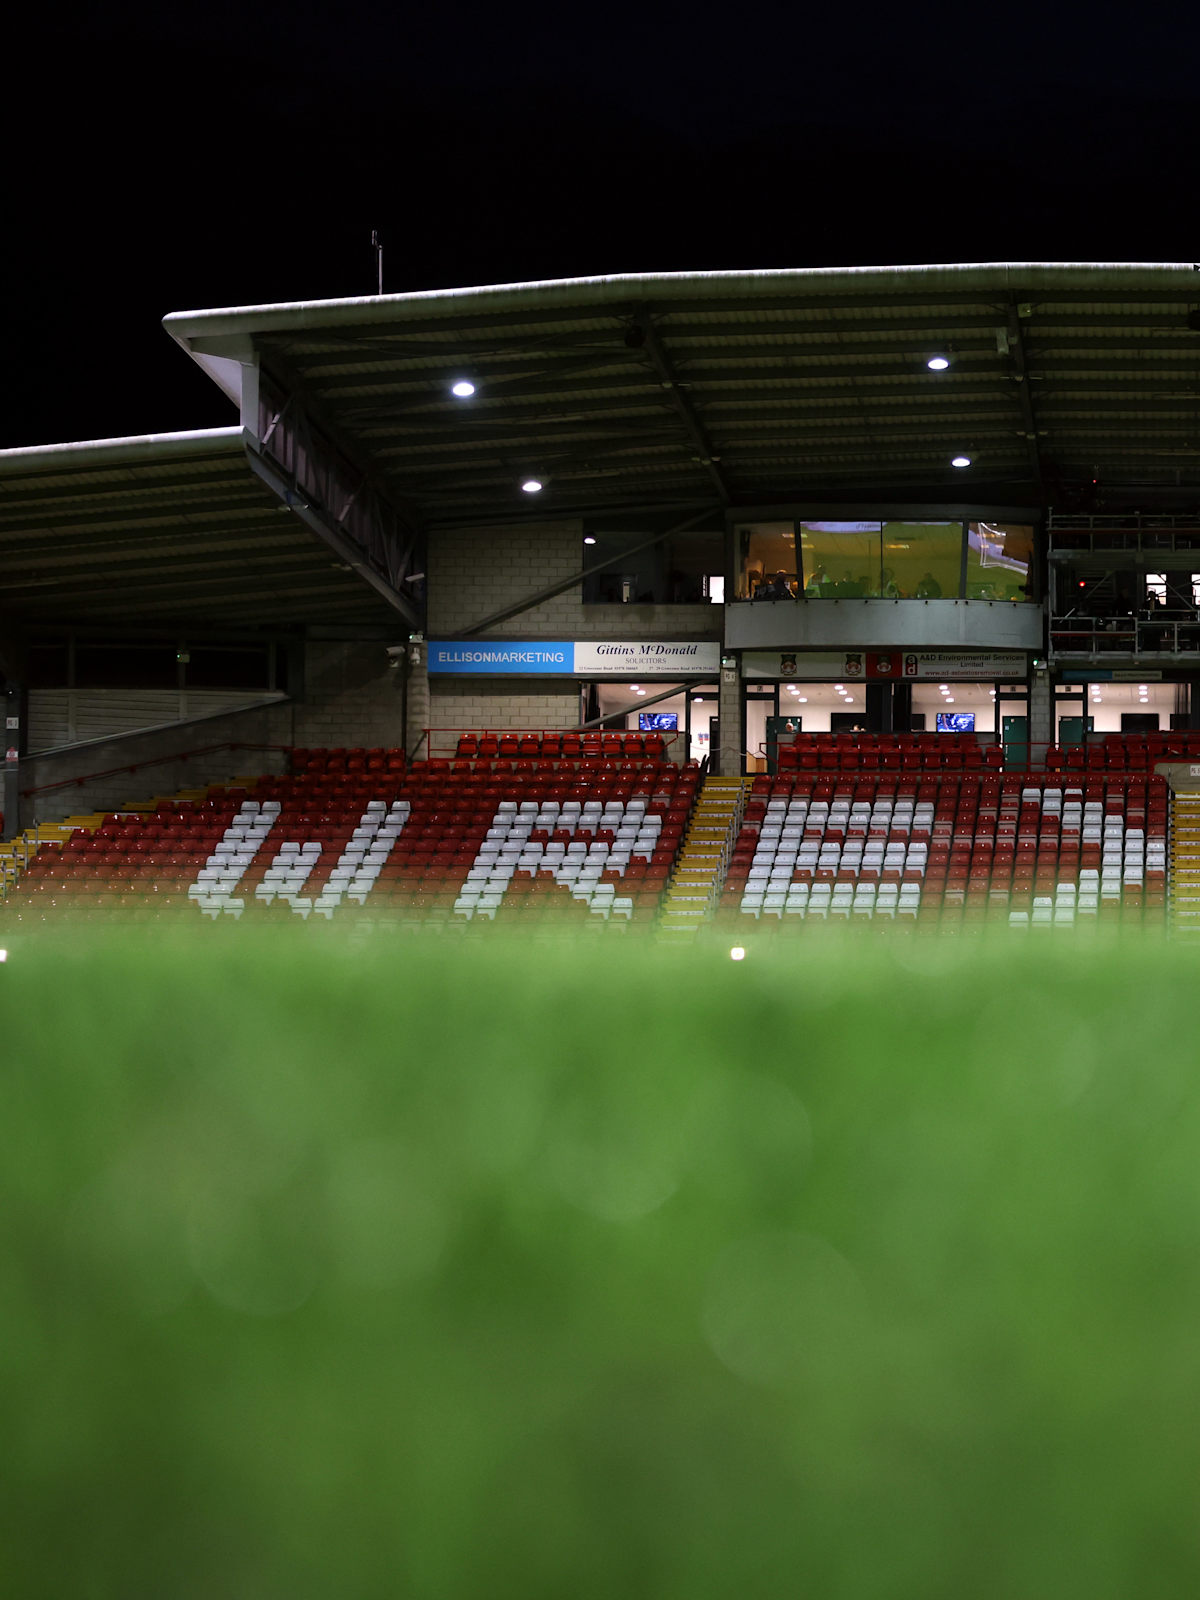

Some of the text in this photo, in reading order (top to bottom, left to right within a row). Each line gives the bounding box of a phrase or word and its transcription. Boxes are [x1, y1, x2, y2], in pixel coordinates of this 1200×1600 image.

[596, 644, 698, 656] Gittins McDonald
[438, 651, 565, 664] ELLISONMARKETING
[625, 657, 667, 665] SOLICITORS
